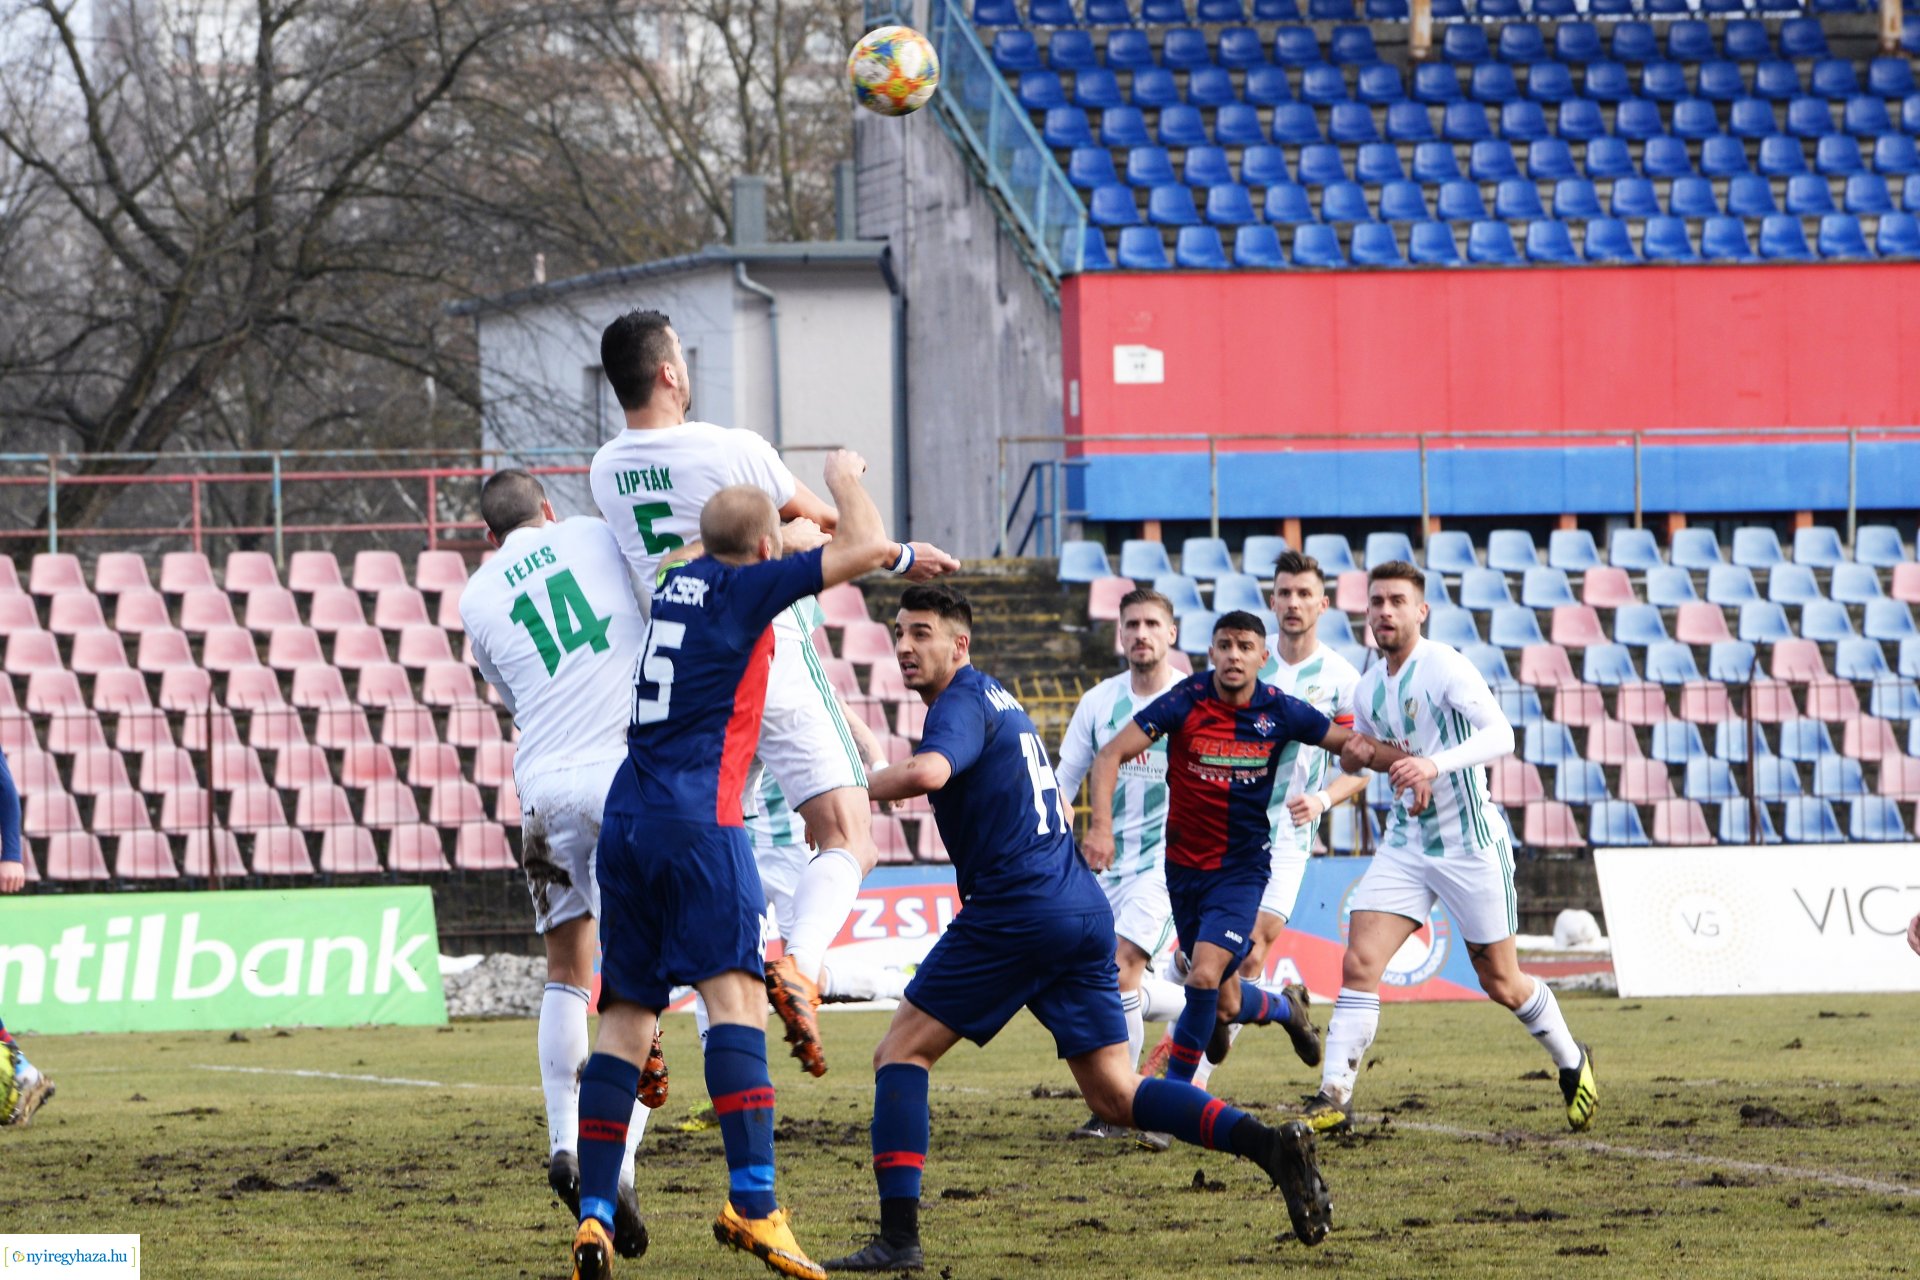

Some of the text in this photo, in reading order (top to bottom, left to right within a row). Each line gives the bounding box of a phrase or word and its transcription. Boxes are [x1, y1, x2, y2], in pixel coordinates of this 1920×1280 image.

[615, 464, 673, 495] LIPTÁK
[633, 501, 685, 556] 5
[504, 545, 557, 588] FEJES
[509, 567, 612, 679] 14
